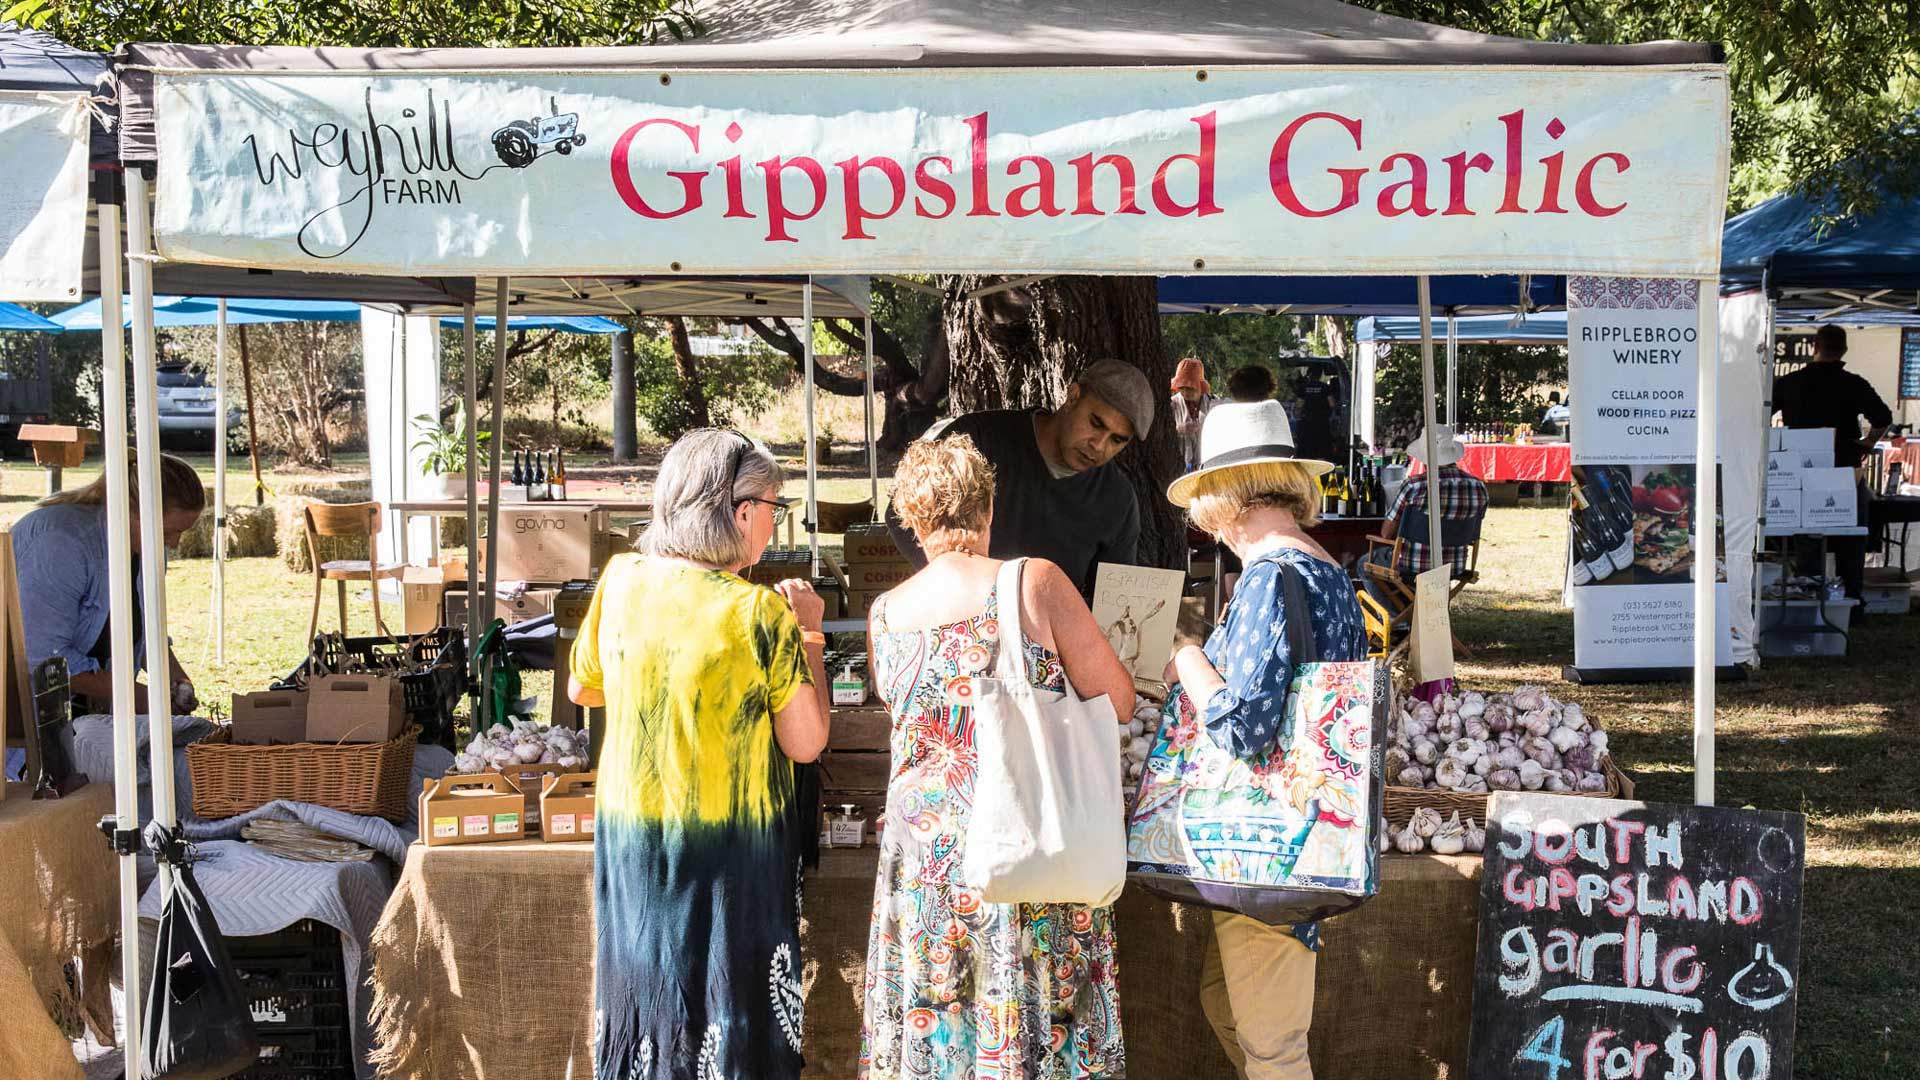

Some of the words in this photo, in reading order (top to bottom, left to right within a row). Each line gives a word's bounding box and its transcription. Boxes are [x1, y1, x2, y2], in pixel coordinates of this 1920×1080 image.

[242, 86, 481, 258] weyhill
[609, 110, 1224, 242] Gippsland
[1268, 108, 1631, 219] Garlic
[383, 179, 462, 205] FARM
[1582, 326, 1697, 343] RIPPLEBROO
[1794, 337, 1816, 357] riv
[1612, 349, 1682, 365] WINERY
[1611, 390, 1649, 401] CELLAR
[1652, 390, 1685, 401] DOOR
[1597, 407, 1630, 418] WOOD
[1633, 408, 1667, 419] FIRED
[1670, 409, 1697, 419] PIZZ
[1627, 425, 1670, 436] CUCINA
[1633, 612, 1683, 623] Westernport
[1612, 623, 1660, 633] Ripplebrook
[1661, 623, 1676, 632] VIC
[1593, 635, 1695, 645] www.ripplebrookwinery.co
[1497, 810, 1684, 870] SOUTH
[1503, 864, 1764, 926] GIPPSLAND
[1498, 915, 1703, 998] garlic
[1514, 1014, 1572, 1080] 4
[1664, 1023, 1772, 1080] $10
